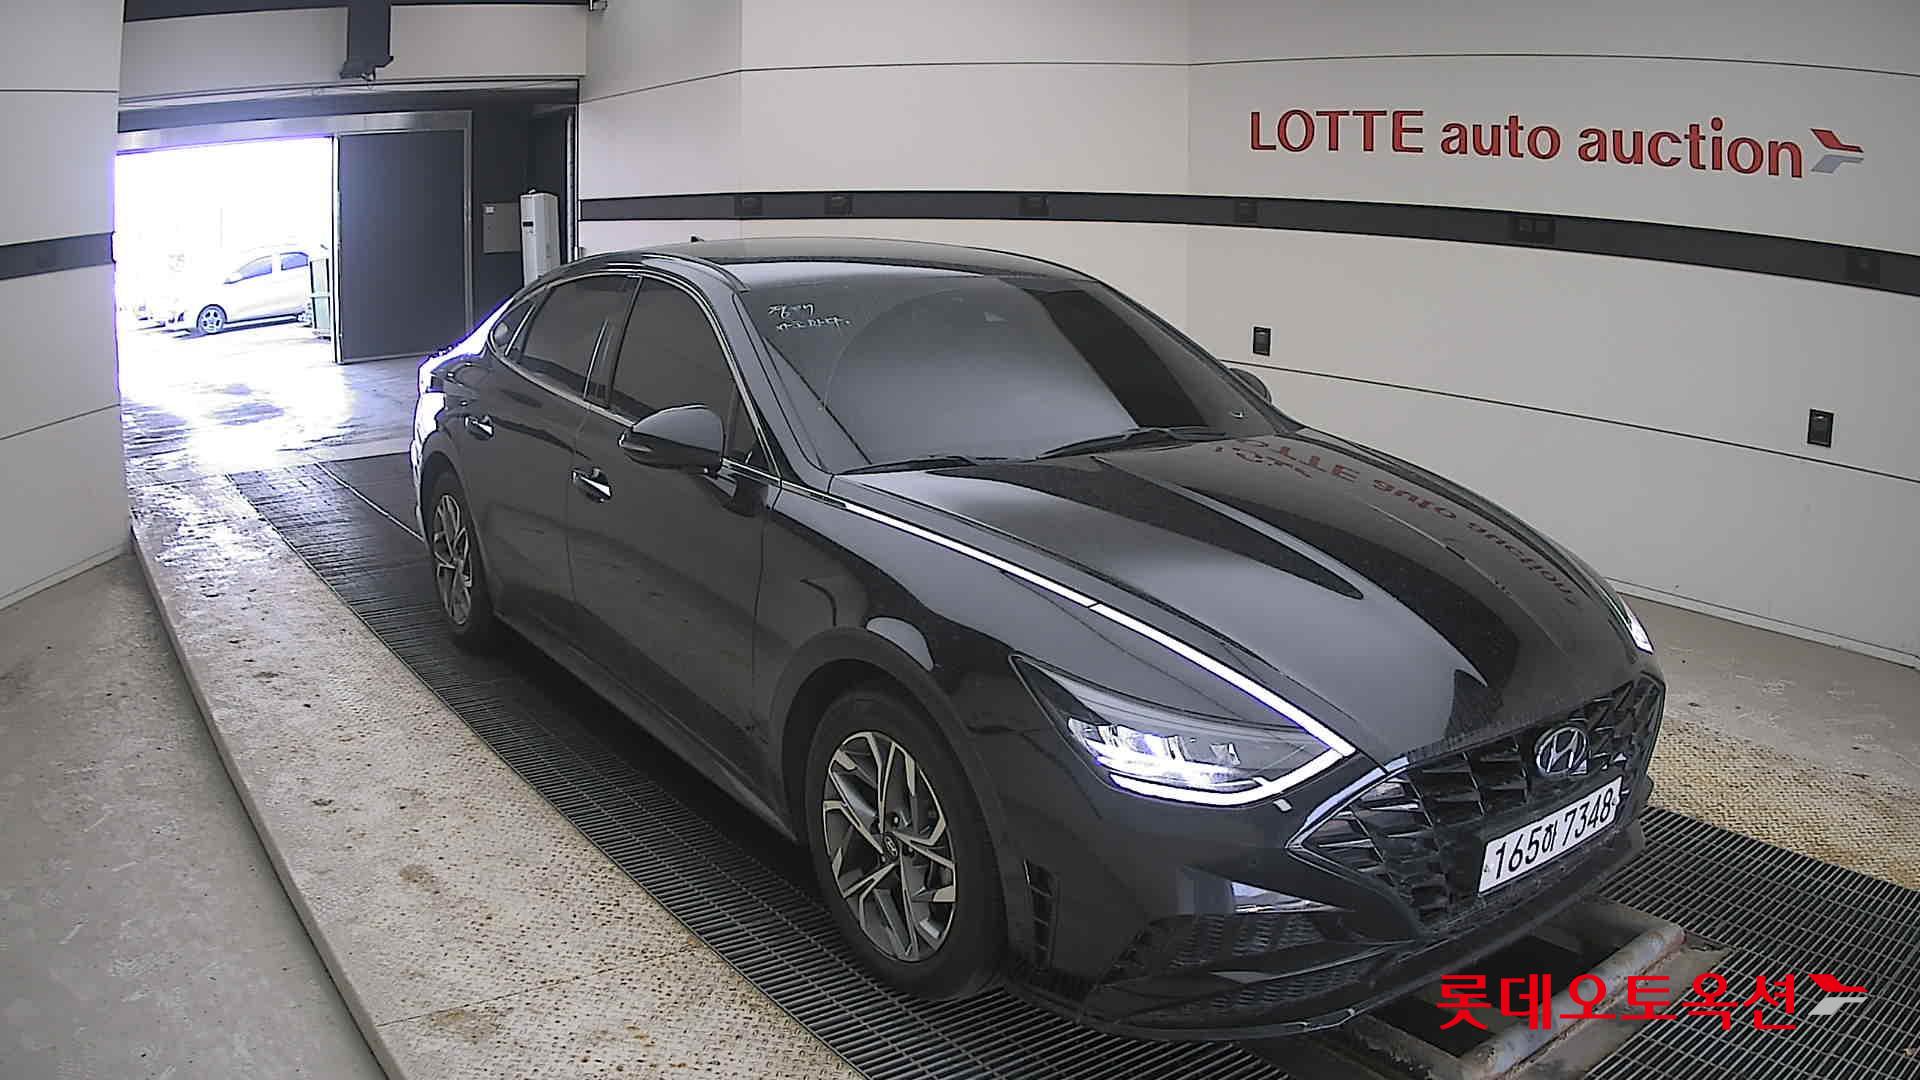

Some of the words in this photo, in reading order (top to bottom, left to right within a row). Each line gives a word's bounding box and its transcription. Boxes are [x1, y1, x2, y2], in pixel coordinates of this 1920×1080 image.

[1249, 109, 1426, 155] LOTTE
[1440, 115, 1563, 161] auto
[1576, 116, 1804, 179] auction
[1495, 819, 1559, 880] 165하
[1562, 787, 1614, 847] 7348
